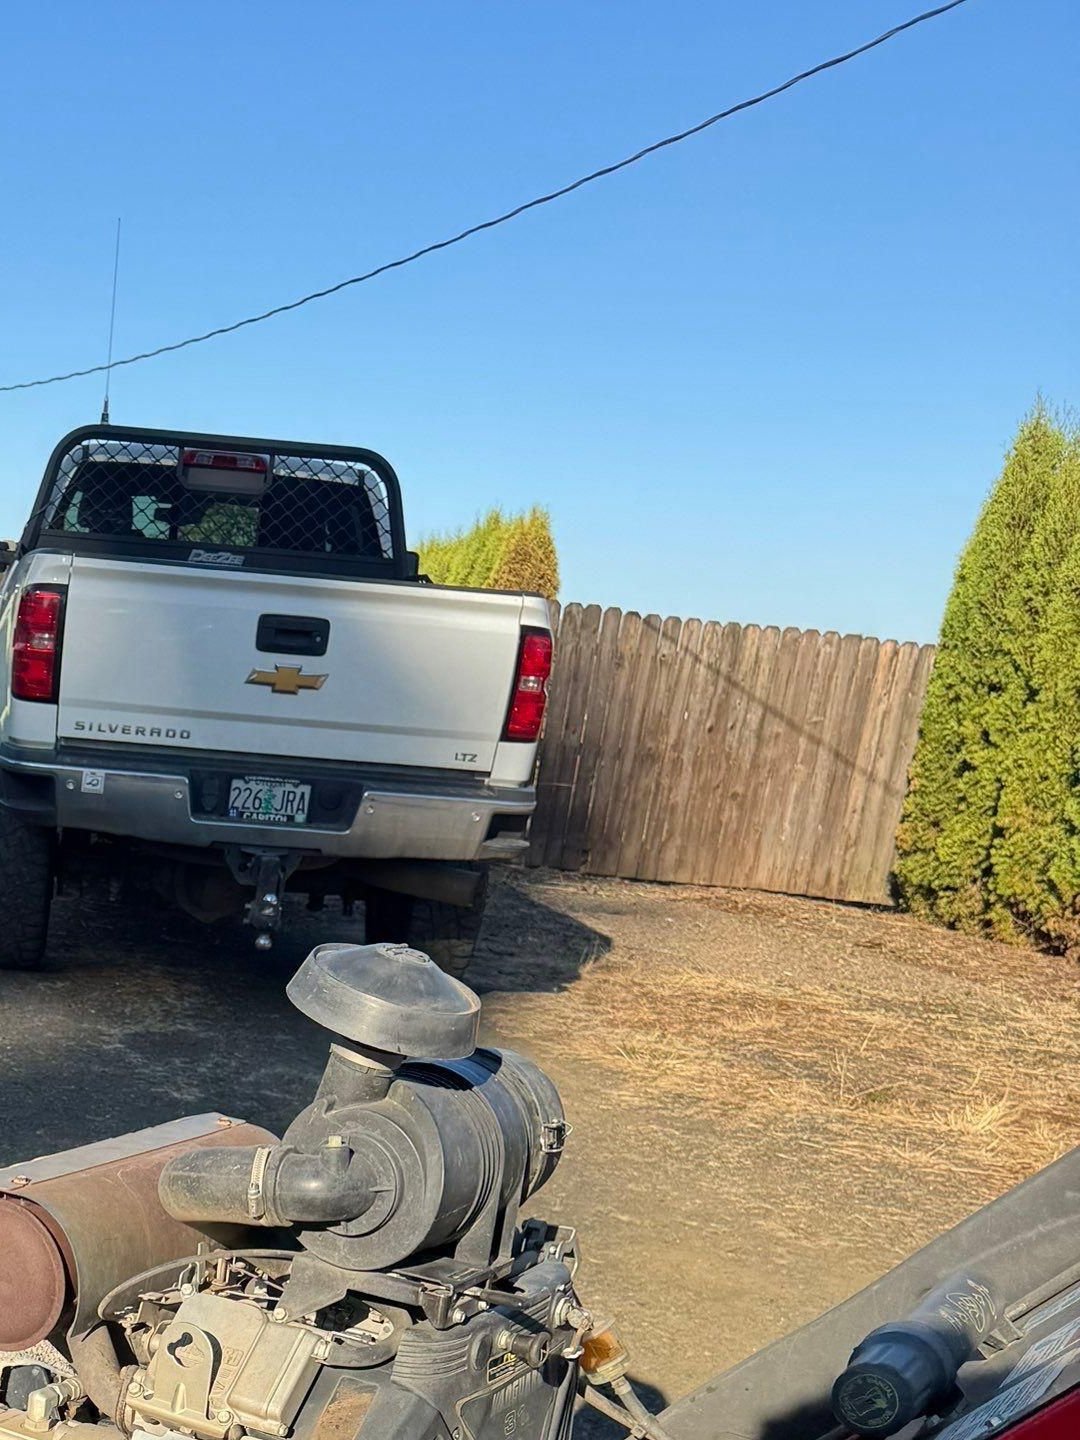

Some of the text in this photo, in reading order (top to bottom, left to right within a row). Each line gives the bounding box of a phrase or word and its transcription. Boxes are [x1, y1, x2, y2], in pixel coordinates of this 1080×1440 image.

[74, 721, 191, 740] SILVERADO
[454, 752, 478, 763] LTZ
[230, 786, 306, 815] 226 JRA
